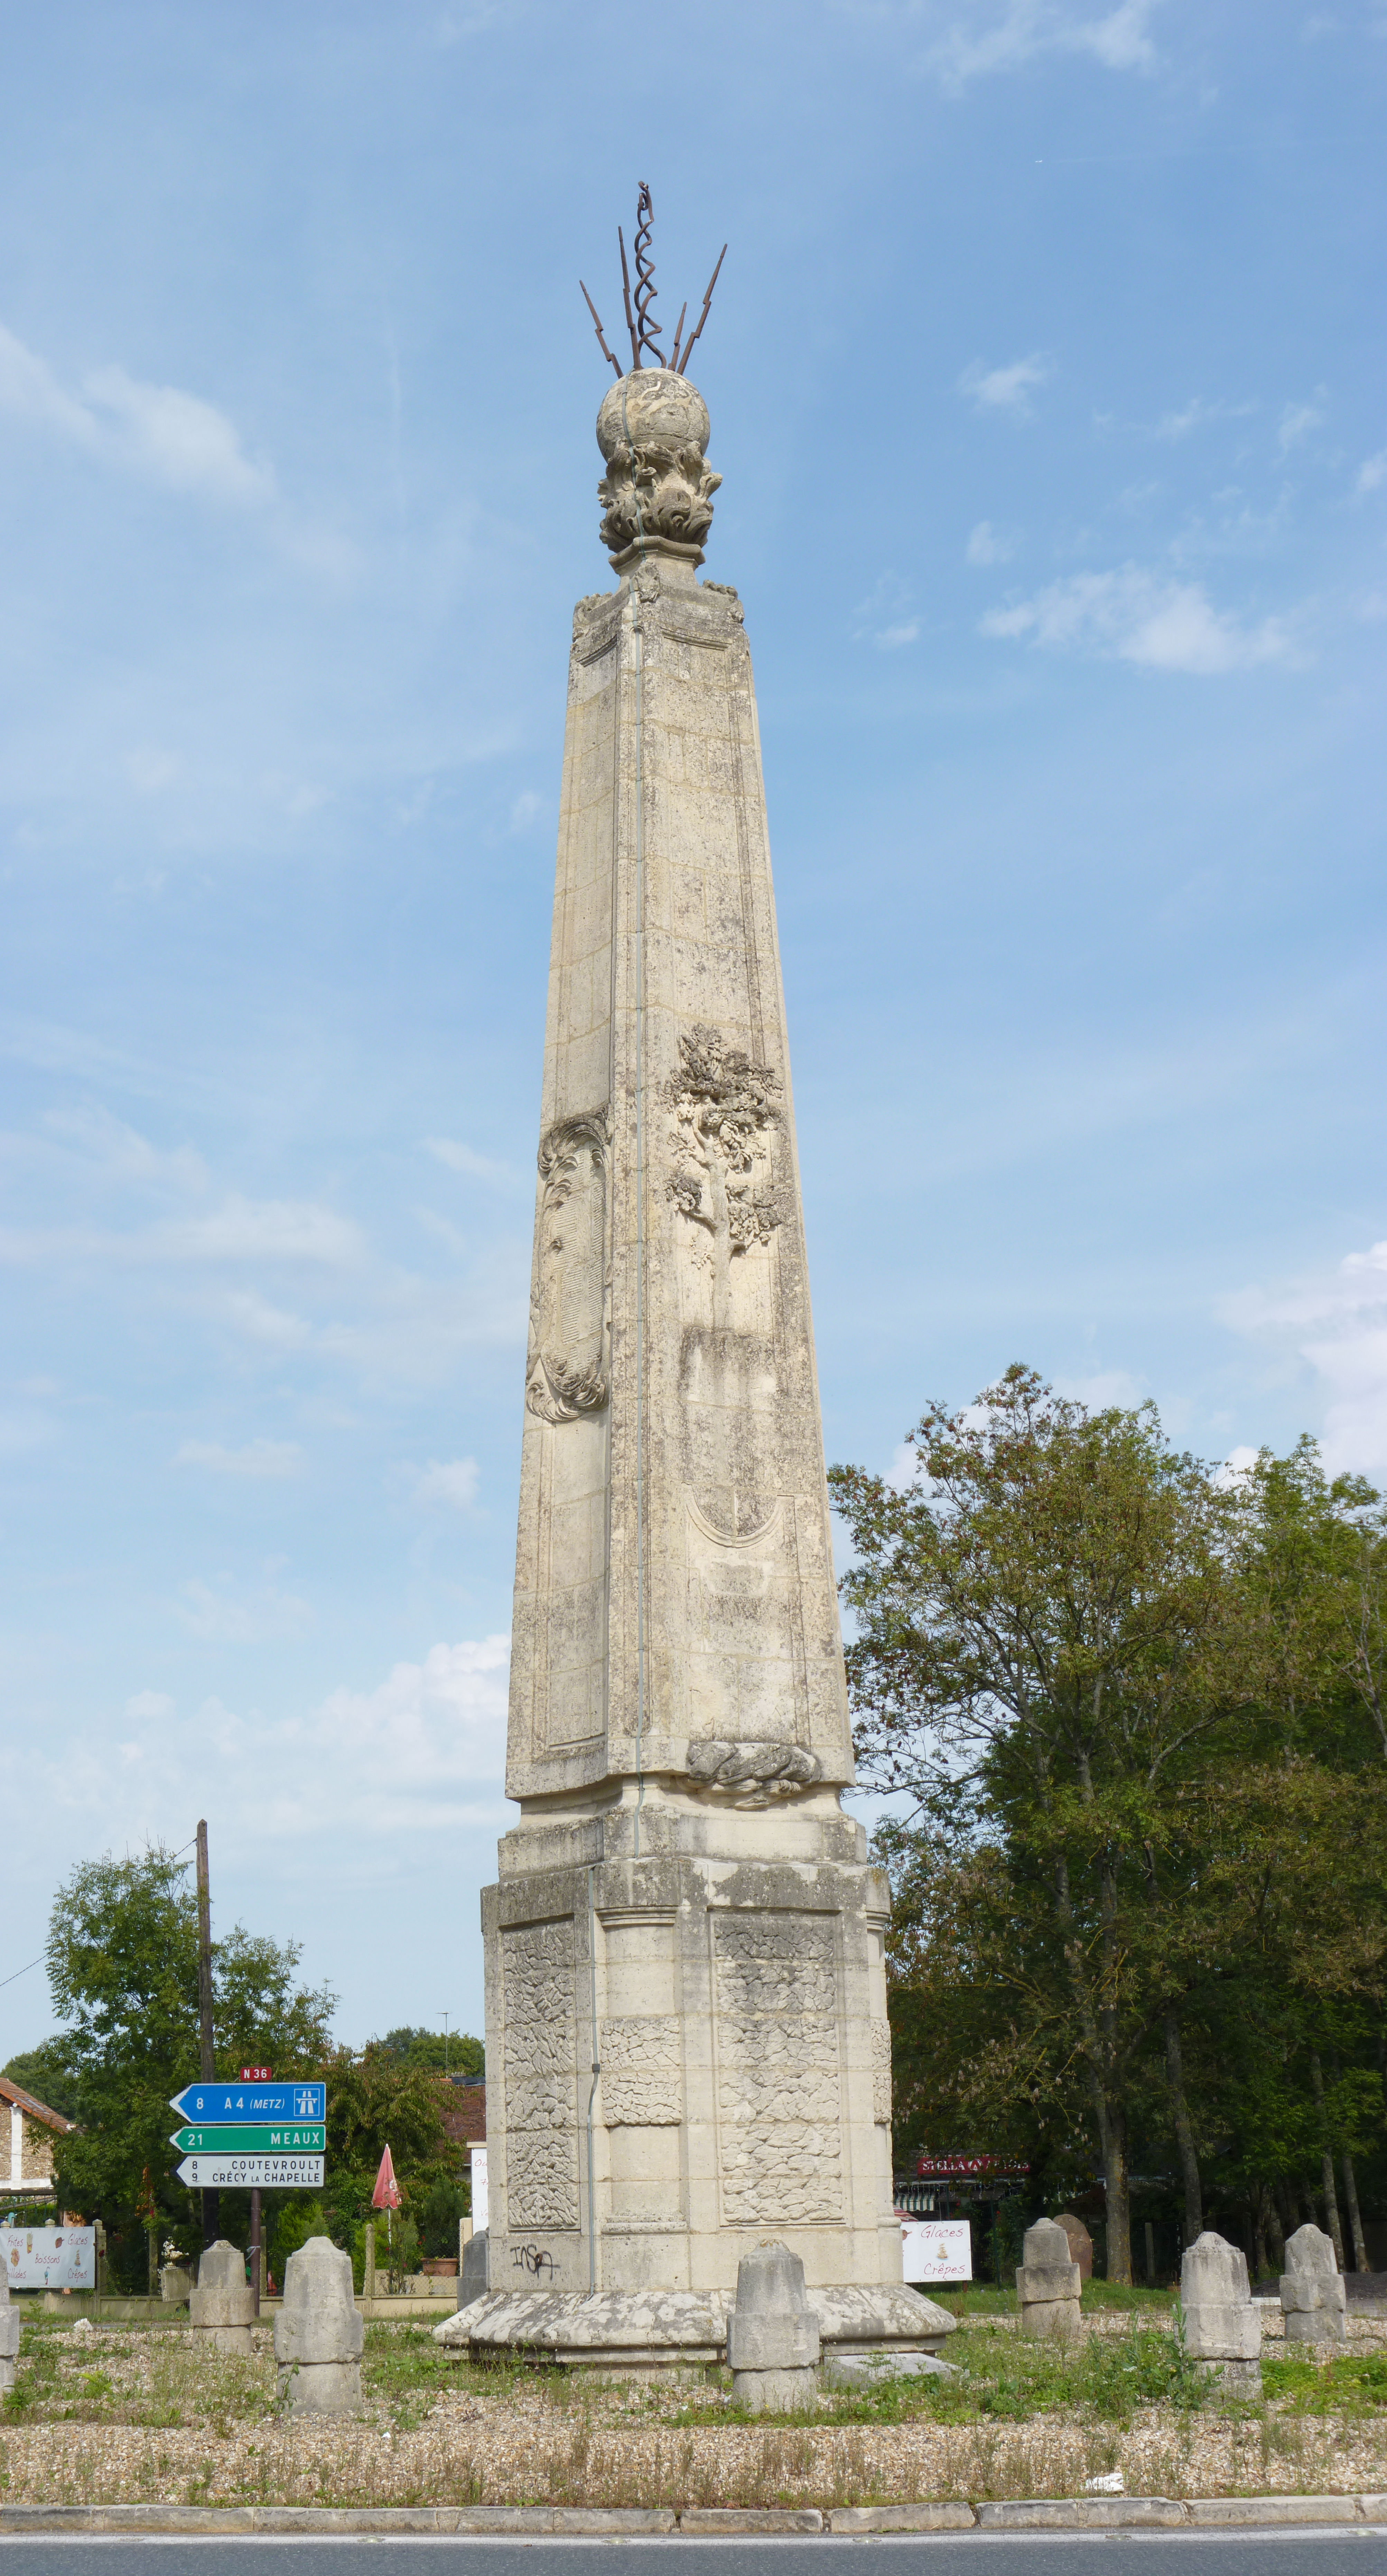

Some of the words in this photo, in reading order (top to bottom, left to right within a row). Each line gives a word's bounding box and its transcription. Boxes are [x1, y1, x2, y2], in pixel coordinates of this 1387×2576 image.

[244, 2069, 250, 2079] N
[254, 2069, 267, 2079] 36
[197, 2098, 204, 2109] 8
[225, 2098, 232, 2109] A
[236, 2097, 243, 2108] 4
[250, 2098, 285, 2110] (METZ)
[188, 2134, 202, 2146] 21
[271, 2132, 319, 2145] MEAUX
[192, 2161, 198, 2169] 8
[232, 2160, 320, 2169] COUTEVROULT
[923, 2161, 965, 2170] STELLA
[192, 2173, 198, 2182] 9
[213, 2171, 246, 2182] CRÉCY
[264, 2173, 319, 2182] CHAPELLE
[921, 2225, 964, 2239] Glaces
[7, 2235, 24, 2247] Frites
[67, 2233, 88, 2246] Glaces
[35, 2253, 60, 2264] Boissons
[7, 2268, 26, 2279] illades
[68, 2269, 87, 2283] Crêpes
[924, 2262, 966, 2278] Crêpes
